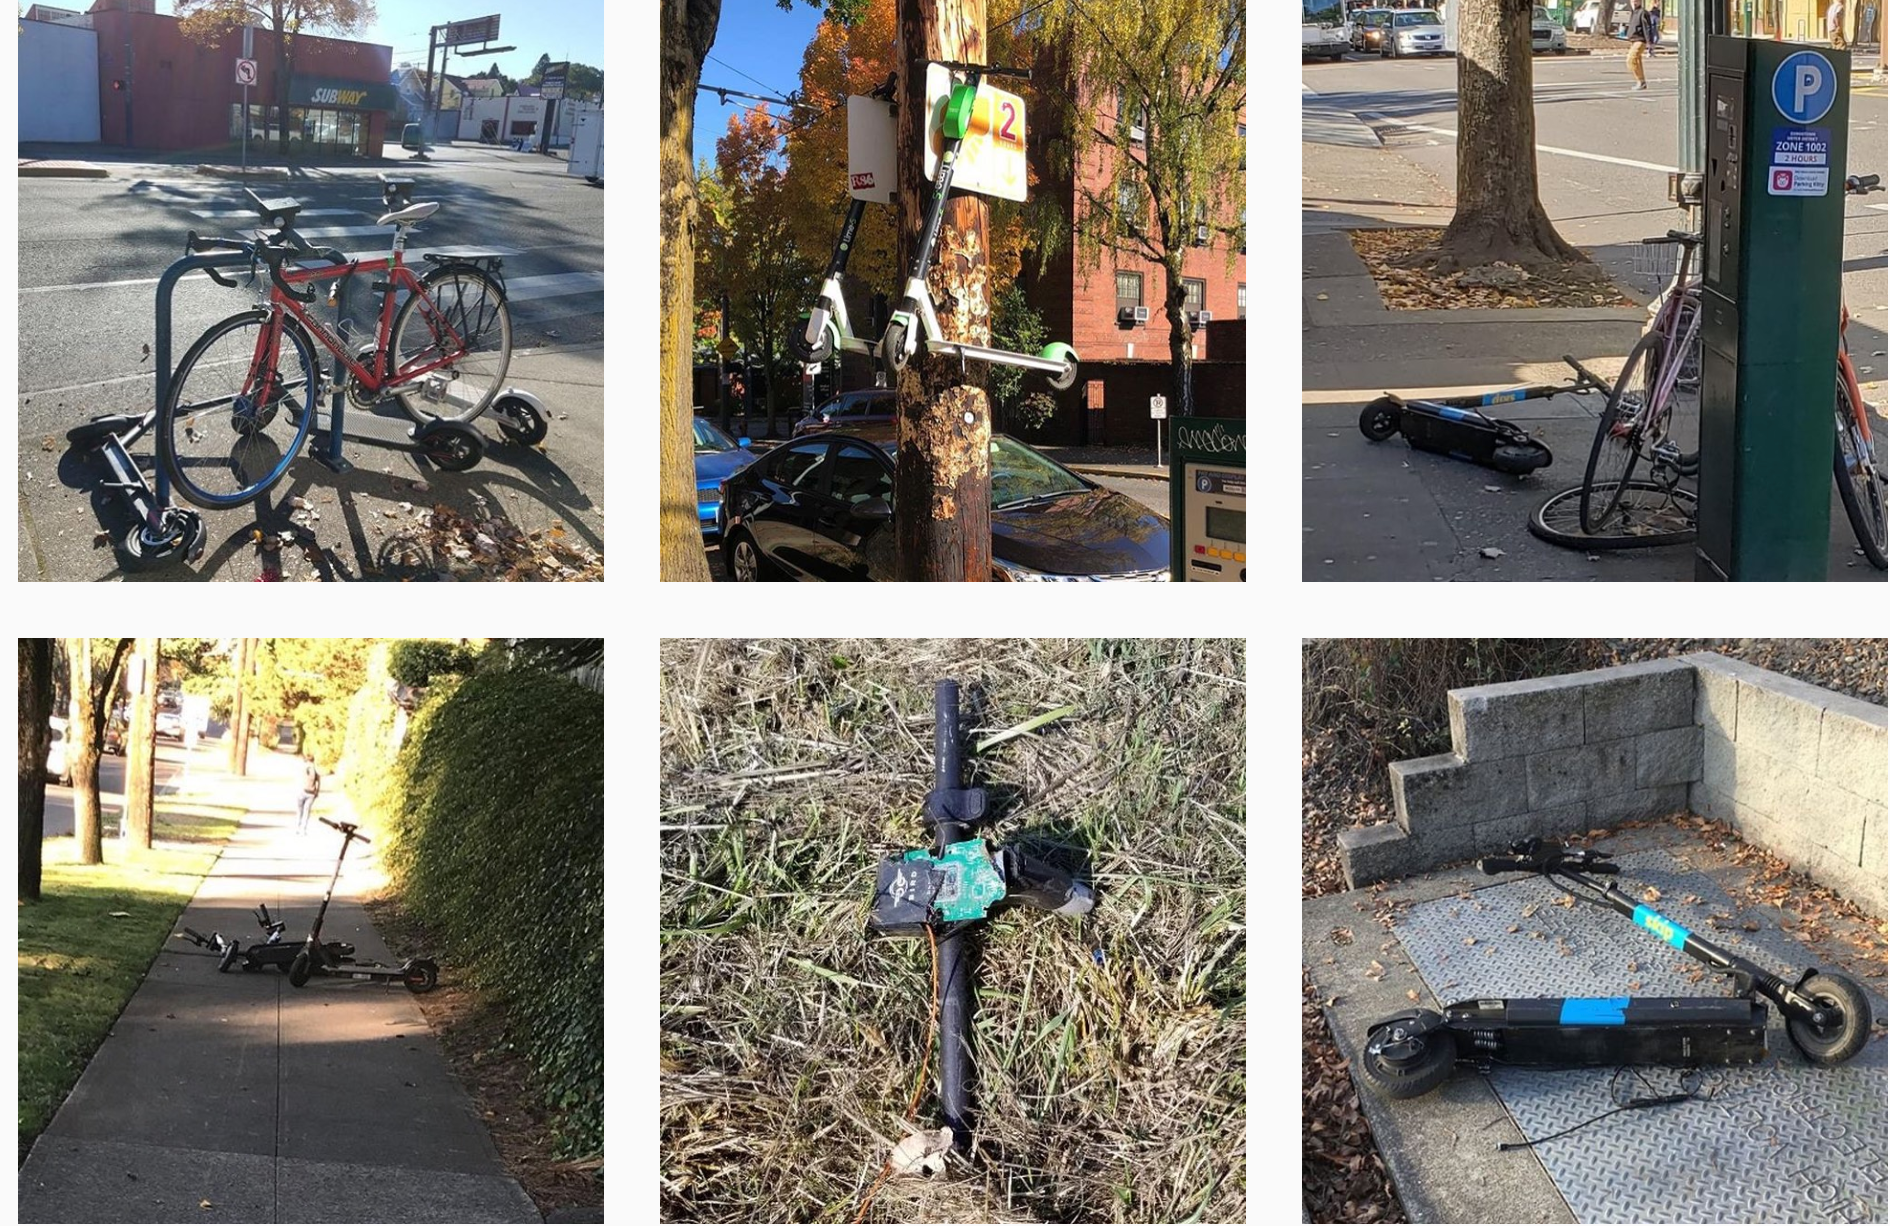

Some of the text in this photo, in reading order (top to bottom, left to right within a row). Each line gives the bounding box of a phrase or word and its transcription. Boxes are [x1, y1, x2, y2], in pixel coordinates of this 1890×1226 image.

[311, 87, 367, 105] SUBWAY
[1794, 65, 1822, 113] P
[1000, 102, 1017, 141] 2
[1776, 141, 1827, 152] ZONE 1002
[908, 870, 917, 901] BIRD
[1645, 914, 1674, 941] skip
